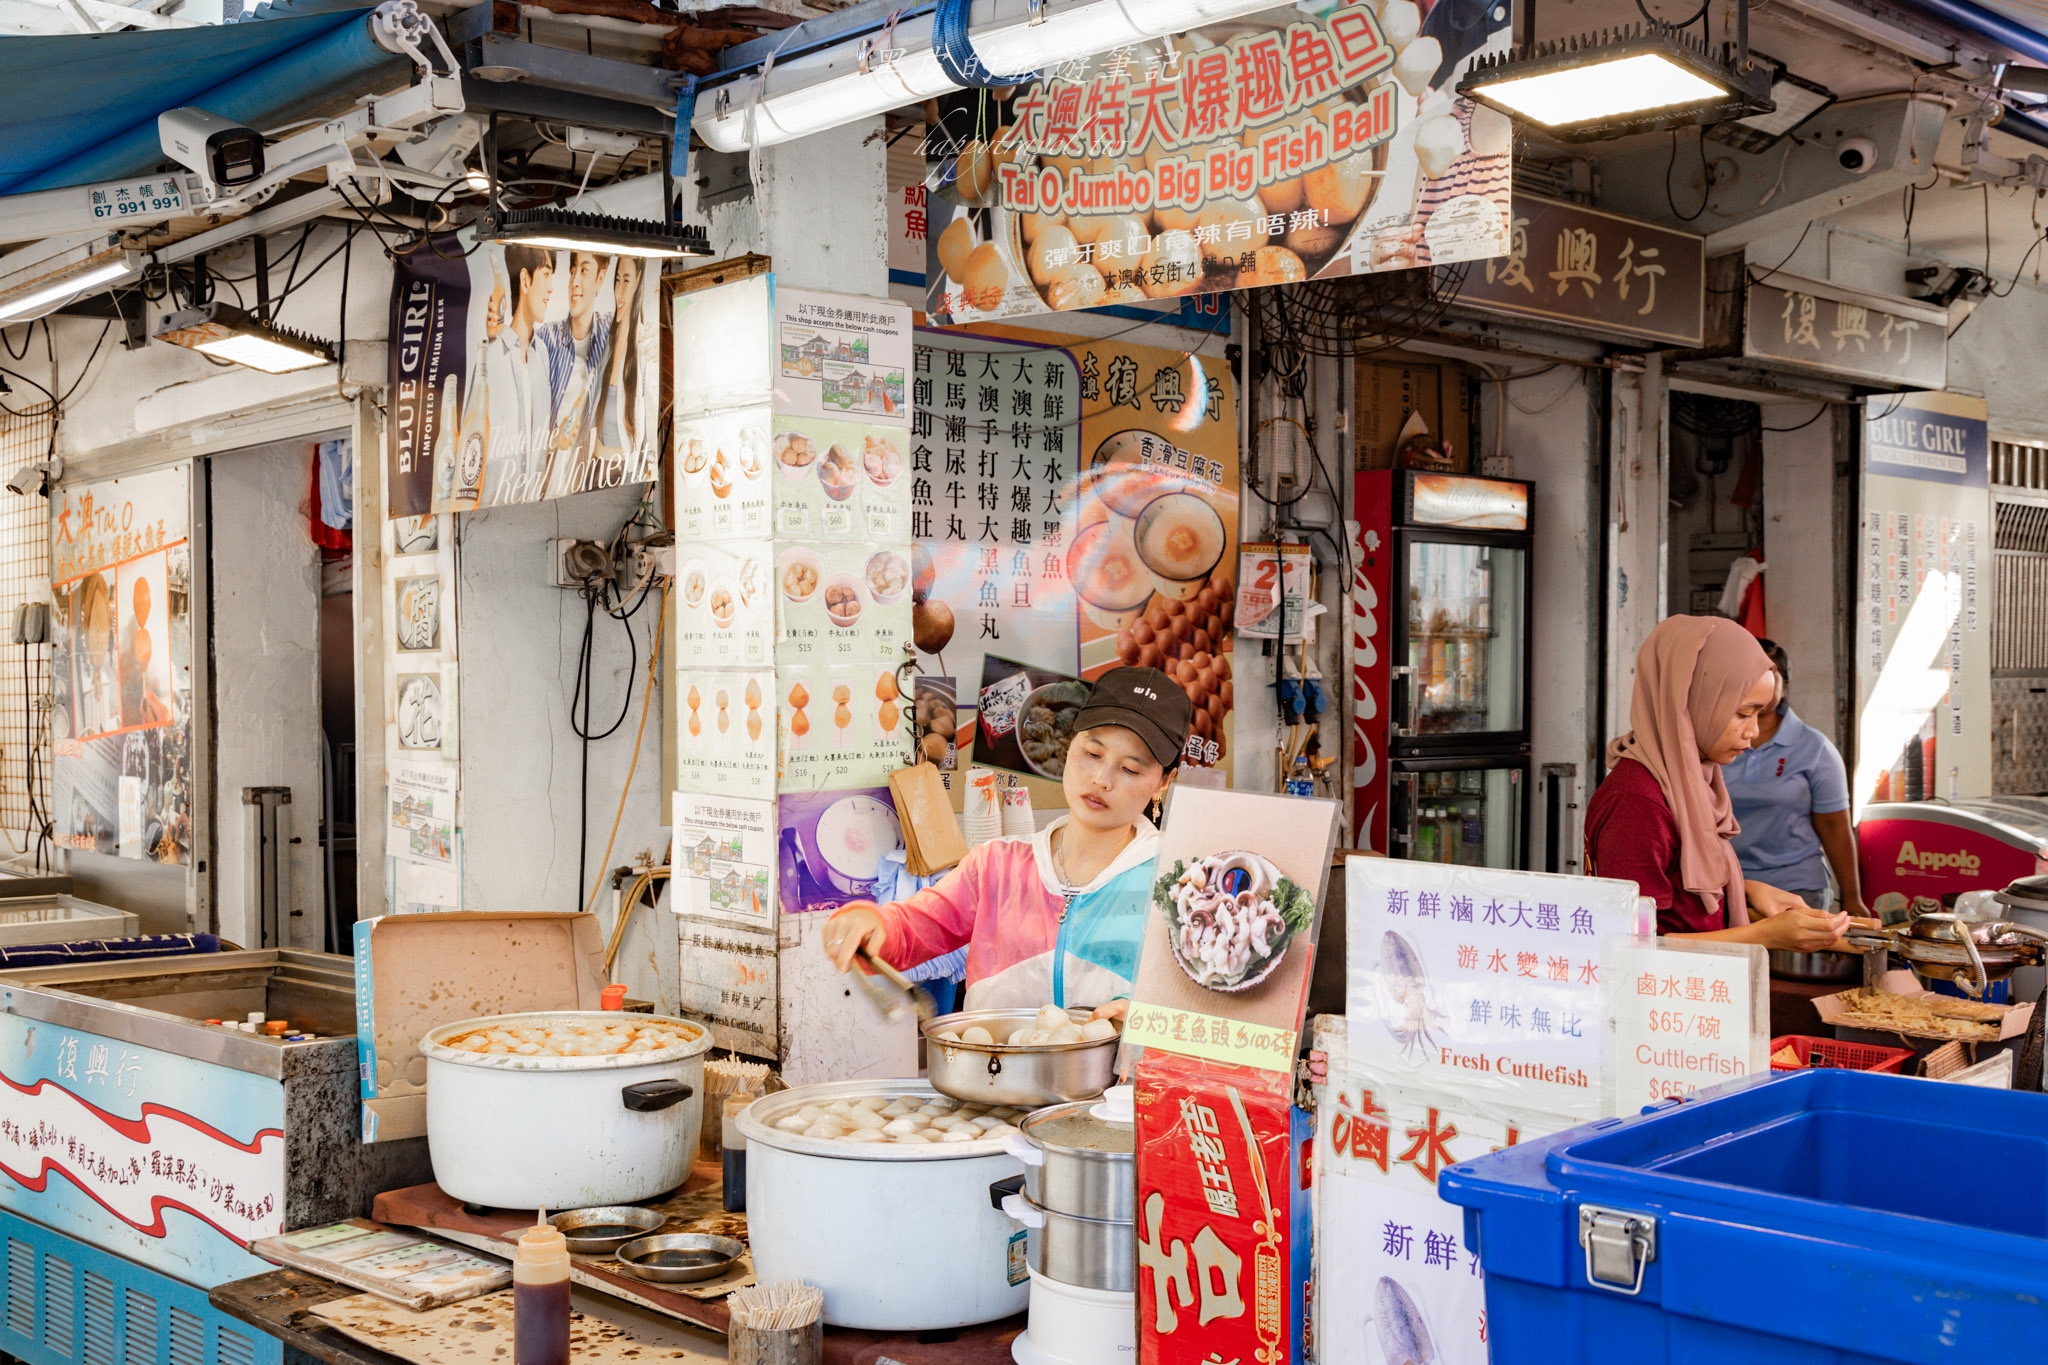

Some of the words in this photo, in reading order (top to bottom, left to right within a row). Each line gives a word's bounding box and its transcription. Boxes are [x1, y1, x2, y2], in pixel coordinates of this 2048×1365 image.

[1005, 9, 1390, 153] 大澳特大爆趣魚旦
[1667, 107, 1705, 120] LIGHT
[1002, 168, 1035, 208] Tai
[1041, 165, 1060, 208] O
[1067, 164, 1150, 209] Jumbo
[1158, 157, 1201, 206] Big
[1210, 149, 1254, 192] Big
[1263, 124, 1324, 178] Fish
[1333, 90, 1391, 161] Ball
[93, 204, 113, 218] 67
[118, 200, 147, 215] 991
[152, 195, 181, 210] 991
[401, 282, 430, 373] GIRL
[437, 298, 445, 328] BEER
[786, 315, 798, 323] This
[798, 317, 812, 325] shop
[813, 319, 835, 328] accepts
[835, 321, 845, 329] the
[846, 322, 862, 331] below
[863, 325, 875, 333] cash
[876, 327, 899, 336] coupons
[798, 303, 896, 327] 以下現金券適用於此商戶
[1780, 290, 1920, 365] 復興行
[428, 331, 444, 389] PREMIUM
[399, 379, 417, 475] BLUE
[422, 392, 435, 457] IMPORTED
[945, 349, 967, 541] 鬼馬瀨尿牛丸
[1871, 417, 1918, 448] BLUE
[1922, 423, 1966, 455] GIRL
[491, 451, 551, 507] Real
[548, 442, 654, 498] Moment
[1042, 361, 1064, 580] 新鮮滷水大墨魚
[1140, 436, 1224, 484] 香滑豆腐花
[1011, 357, 1032, 608] 大澳特大爆趣魚旦
[798, 644, 812, 652] $15
[838, 644, 852, 652] $15
[880, 646, 893, 655] $70
[1133, 686, 1158, 701] win
[835, 766, 848, 774] $20
[882, 765, 894, 773] $18
[1181, 735, 1220, 764] 蛋仔
[795, 769, 808, 777] $16
[694, 818, 704, 826] shop
[704, 820, 719, 828] accepts
[726, 822, 738, 830] below
[1896, 841, 1981, 871] Appolo
[1386, 888, 1597, 936] 新鮮滷水大墨魚
[359, 938, 368, 984] BLUE
[1456, 943, 1601, 986] 游水變滷水
[1637, 971, 1732, 1005] 鹵水墨魚
[1469, 998, 1583, 1038] 鮮味無比
[1648, 1008, 1721, 1040] $65/碗
[56, 1034, 143, 1098] 復興行
[1440, 1047, 1491, 1074] Fresh
[1495, 1054, 1590, 1089] Cuttlefish
[1635, 1043, 1746, 1077] Cuttlerfish
[1648, 1077, 1697, 1102] $65/
[1178, 1098, 1240, 1219] 喝王老吉
[1138, 1191, 1245, 1335] 吉
[1382, 1219, 1484, 1280] 新鮮
